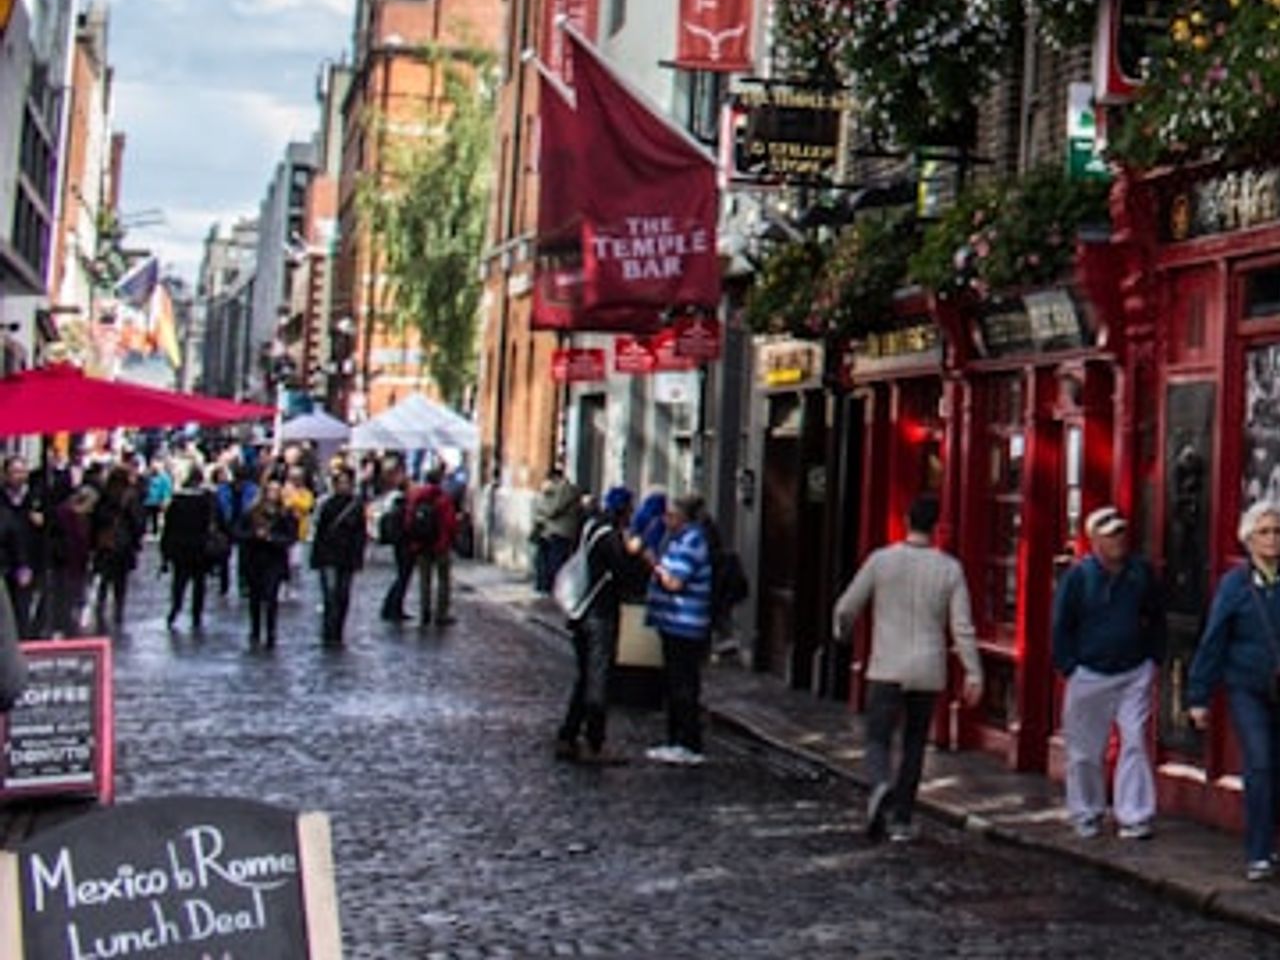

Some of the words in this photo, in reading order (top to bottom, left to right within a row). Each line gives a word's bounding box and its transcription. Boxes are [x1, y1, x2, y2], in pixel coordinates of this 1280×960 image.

[627, 216, 673, 235] THE
[593, 229, 708, 260] TEMPLE
[622, 255, 683, 280] BAR
[30, 846, 167, 912] Mexico
[184, 824, 297, 889] Rome
[67, 898, 181, 960] Lunch
[184, 886, 266, 941] Deal
